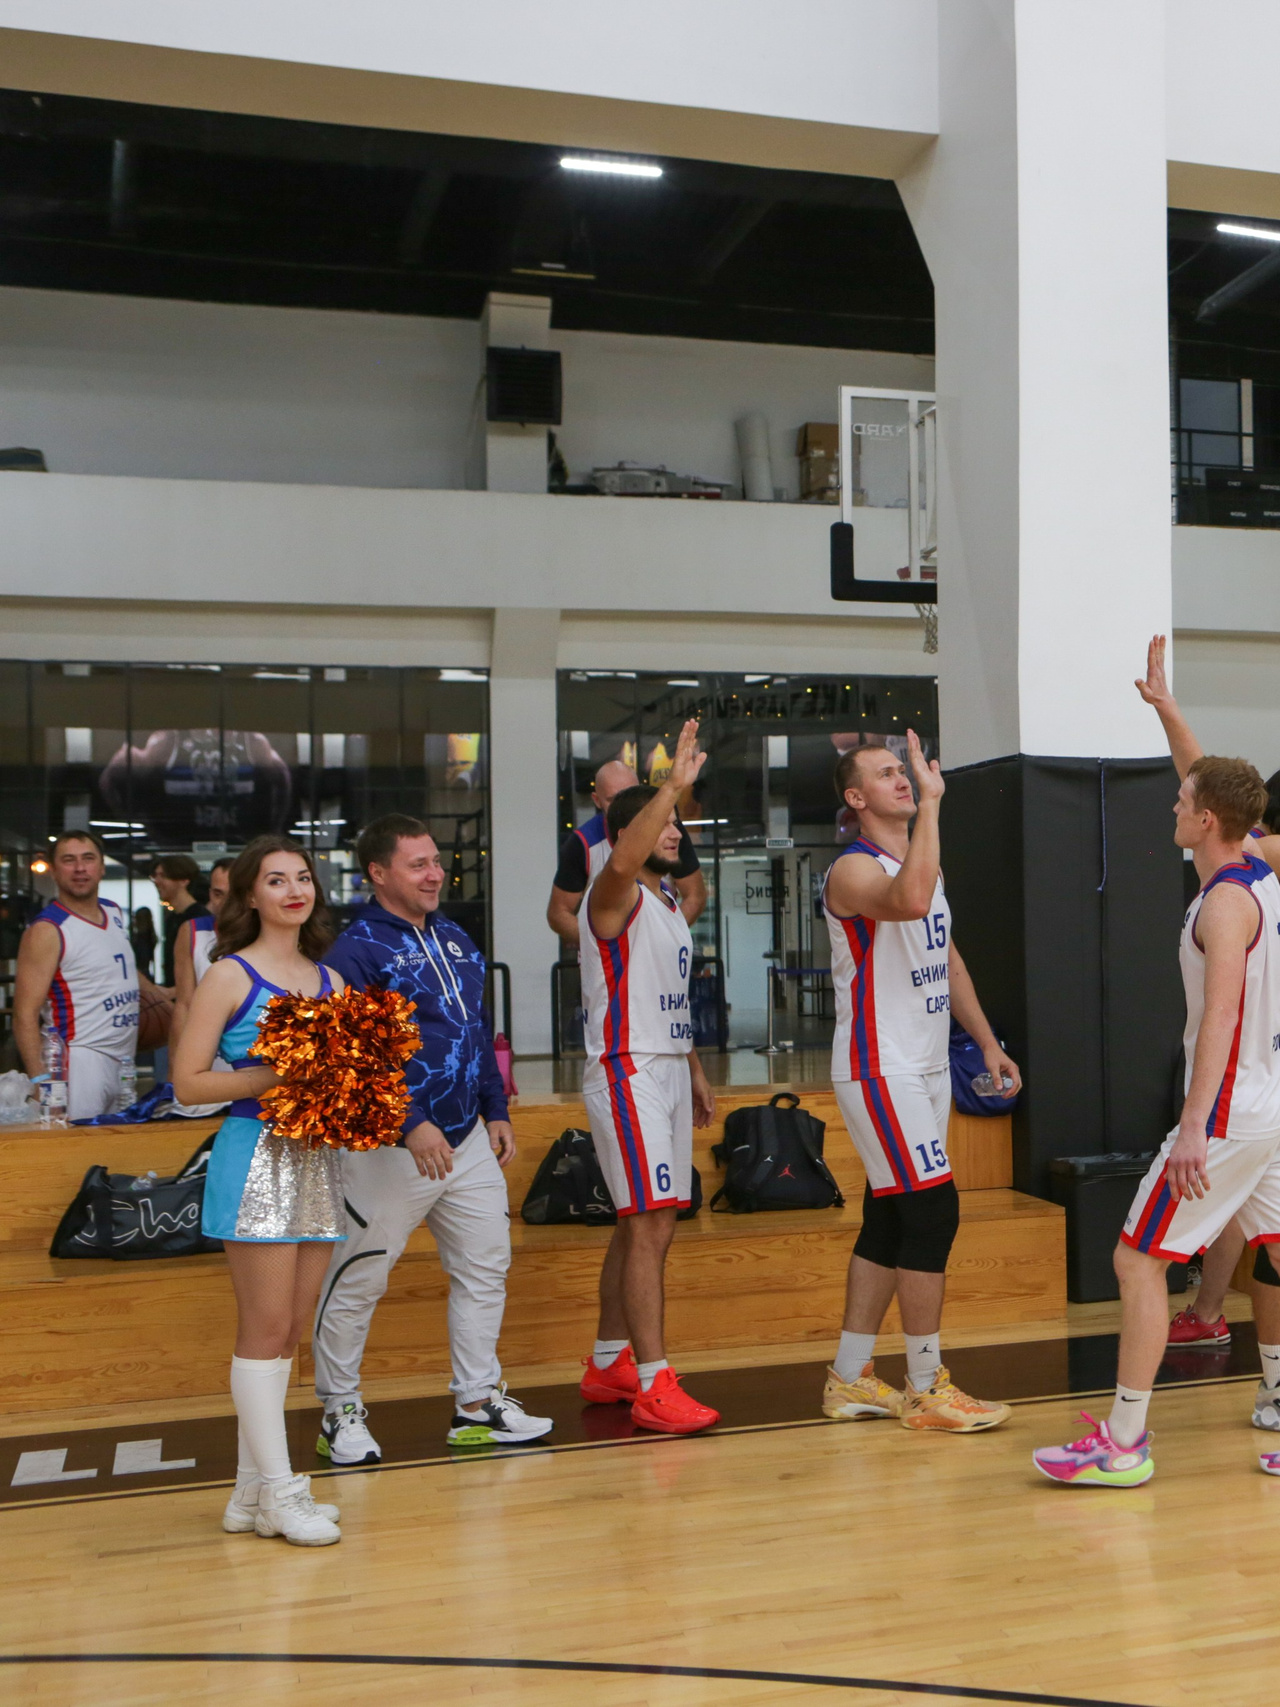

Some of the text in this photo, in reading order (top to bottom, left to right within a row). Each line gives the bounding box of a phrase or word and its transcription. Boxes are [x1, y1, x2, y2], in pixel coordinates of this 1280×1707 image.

[923, 913, 946, 950] 15
[114, 953, 128, 980] 7
[678, 946, 688, 979] 6
[911, 963, 949, 988] ВНИИ
[915, 1139, 947, 1173] 15
[656, 1163, 671, 1192] 6
[569, 1203, 615, 1215] LEX
